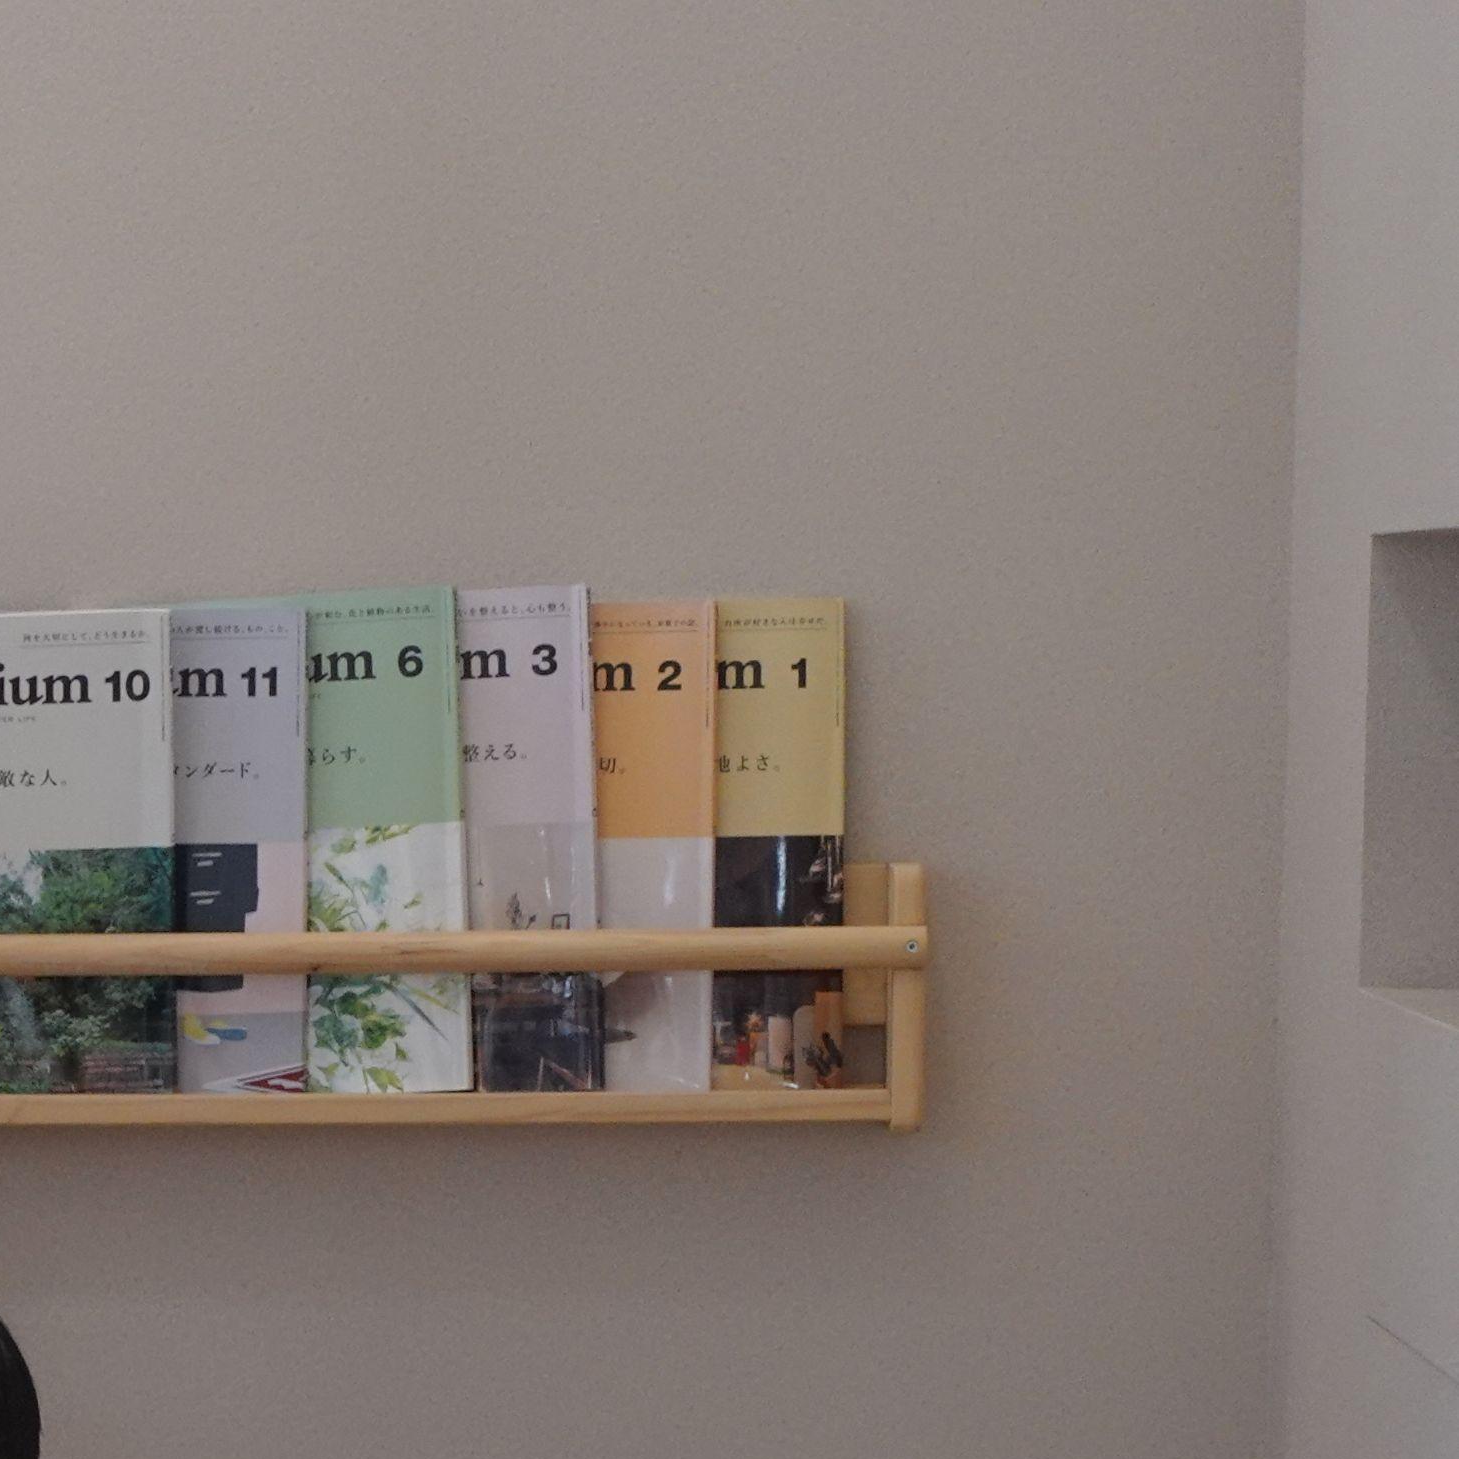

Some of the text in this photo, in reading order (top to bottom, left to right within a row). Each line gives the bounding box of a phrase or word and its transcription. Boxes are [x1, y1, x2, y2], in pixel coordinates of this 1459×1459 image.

[397, 645, 424, 678] 6
[532, 643, 558, 676] 3
[657, 659, 683, 692] 2
[791, 657, 808, 689] 1
[105, 668, 151, 702] 10
[241, 666, 278, 698] 11
